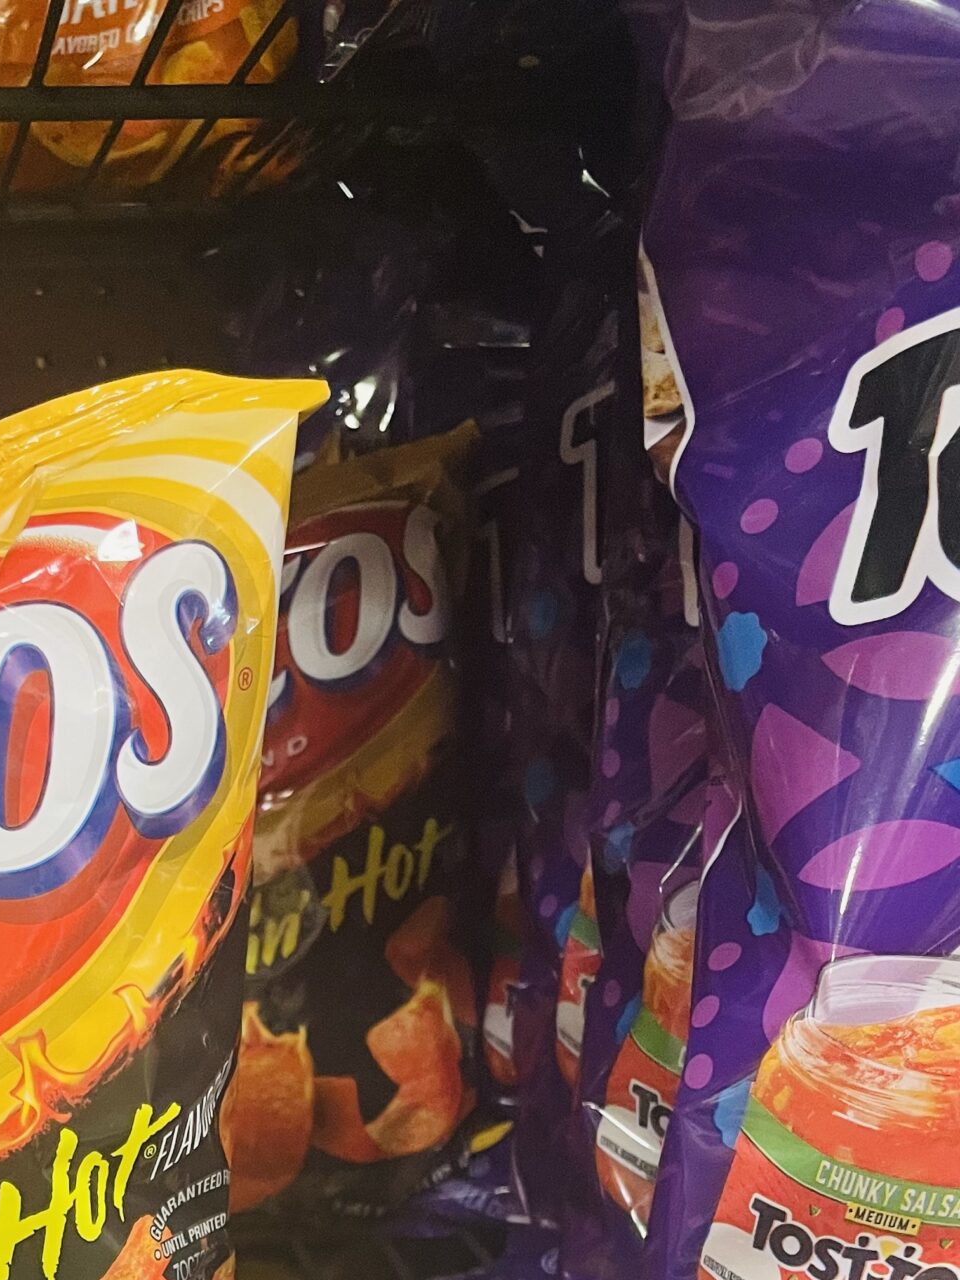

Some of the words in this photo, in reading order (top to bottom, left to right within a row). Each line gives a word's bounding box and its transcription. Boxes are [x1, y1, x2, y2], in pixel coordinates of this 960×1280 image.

[50, 28, 121, 55] AVORED
[149, 1170, 224, 1242] GUARANTEED
[815, 1159, 899, 1208] CHUNKY
[161, 1231, 189, 1258] UNTIL
[187, 1212, 228, 1243] PRINTED
[853, 1206, 911, 1232] MEDIUM
